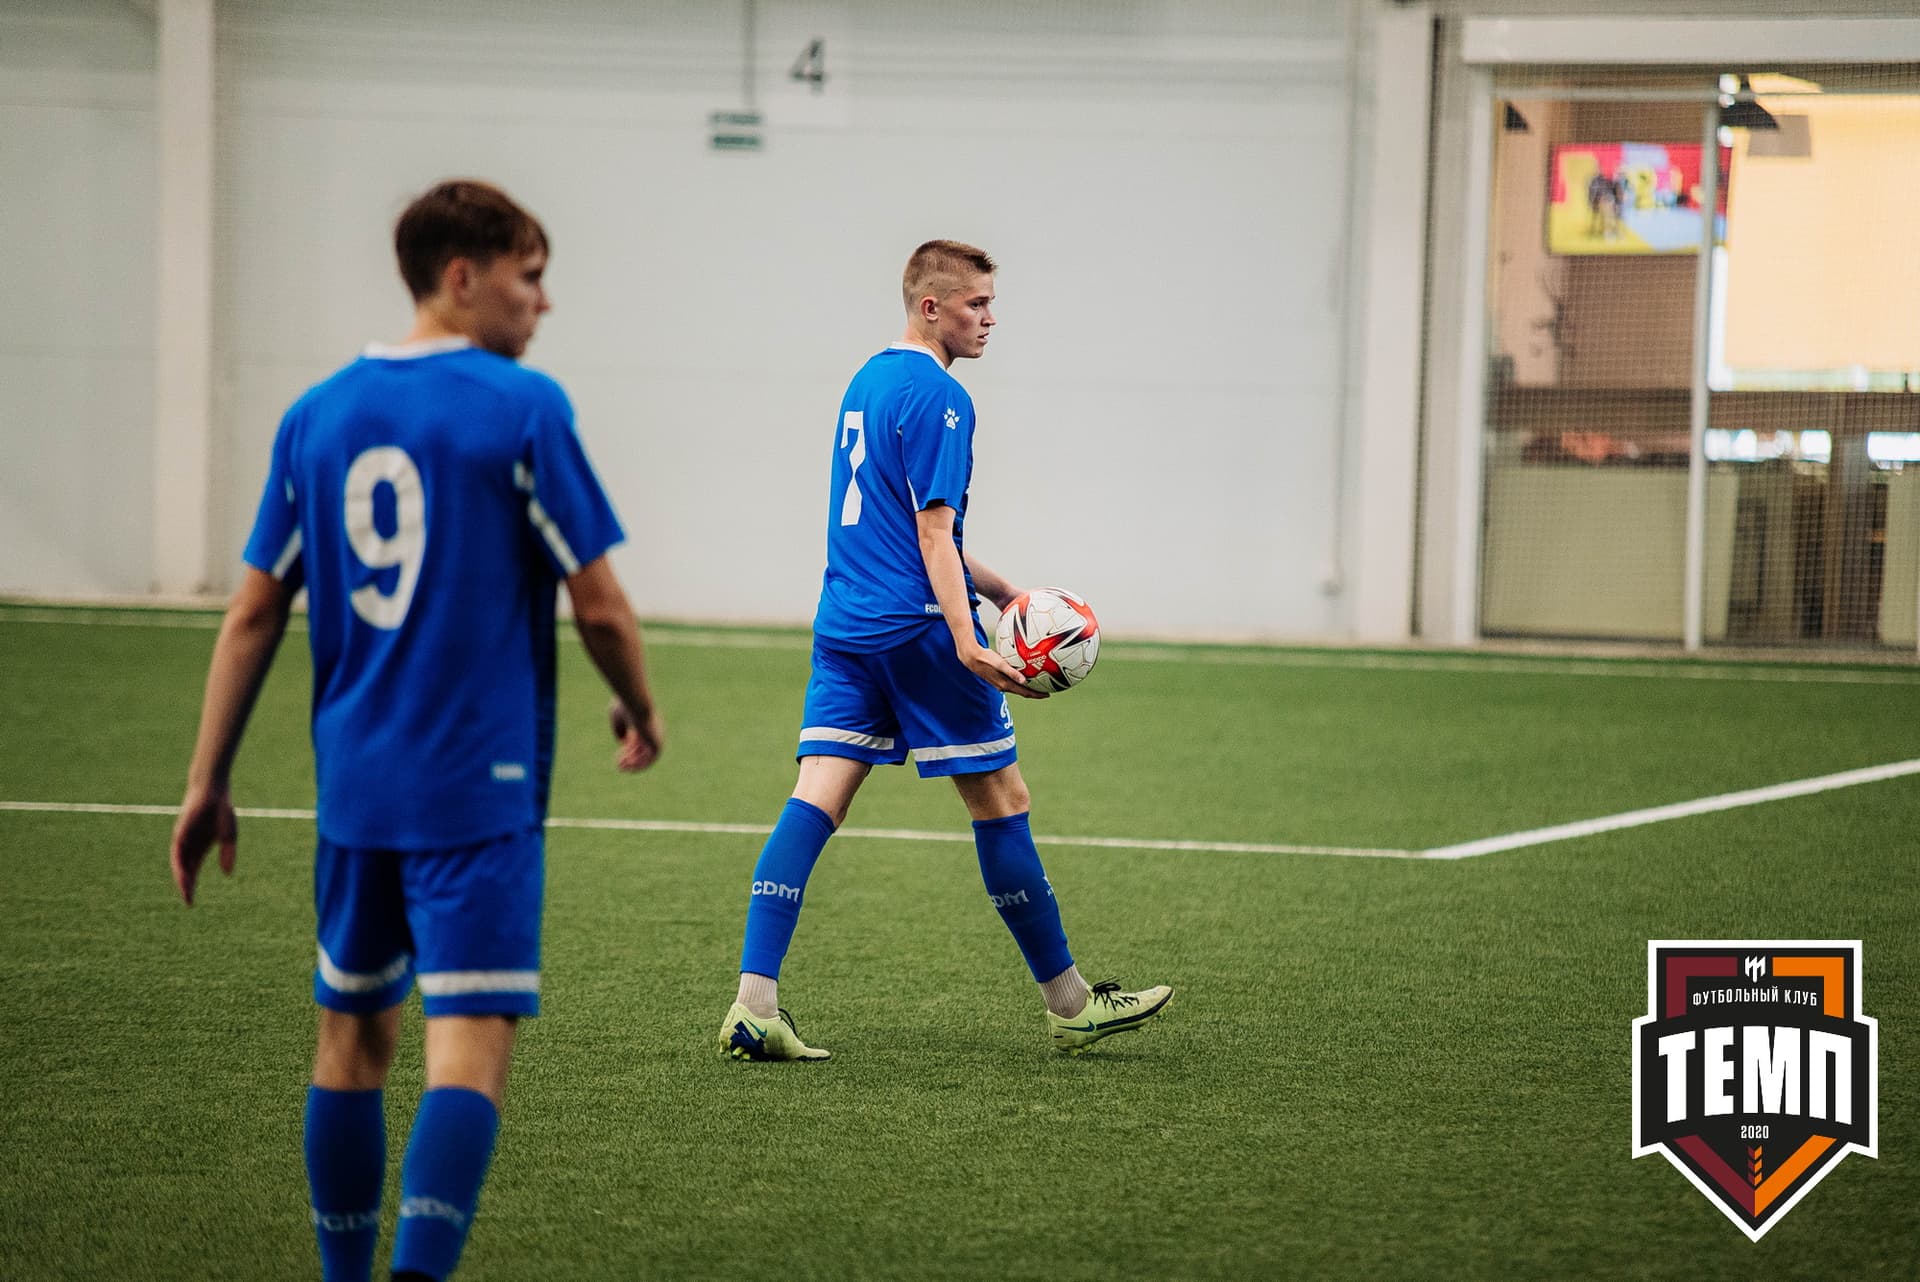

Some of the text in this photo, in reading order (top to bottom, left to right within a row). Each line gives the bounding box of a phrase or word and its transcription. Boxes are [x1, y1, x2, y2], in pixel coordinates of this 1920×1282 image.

[790, 39, 827, 92] 4
[840, 411, 867, 526] 7
[344, 446, 427, 631] 9
[991, 889, 1030, 908] DM
